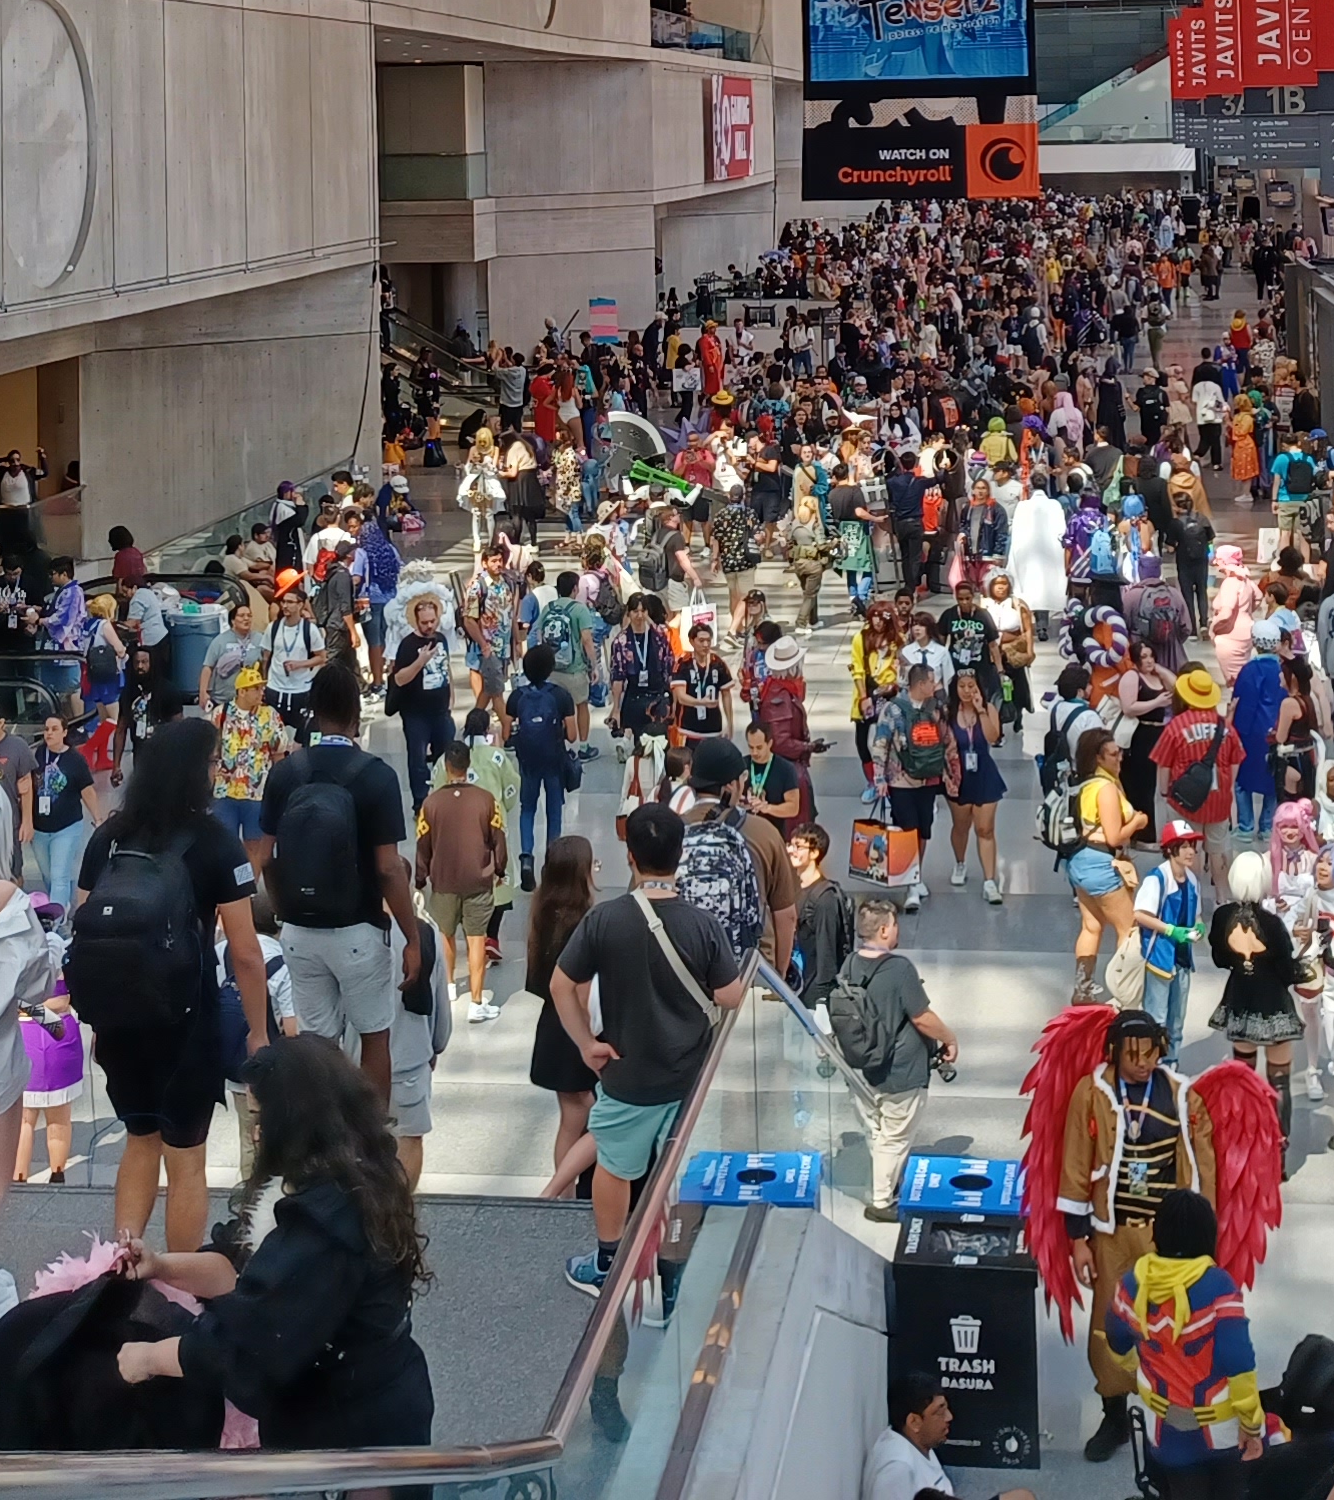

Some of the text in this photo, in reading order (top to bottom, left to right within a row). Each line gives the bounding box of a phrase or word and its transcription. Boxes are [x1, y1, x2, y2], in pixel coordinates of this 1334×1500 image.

[1191, 19, 1206, 85] JAVITS
[1267, 86, 1305, 114] 1B
[879, 147, 949, 161] WATCH ON
[838, 164, 953, 186] Crunchyroll
[937, 1357, 995, 1374] TRASH
[941, 1377, 994, 1390] BASURA
